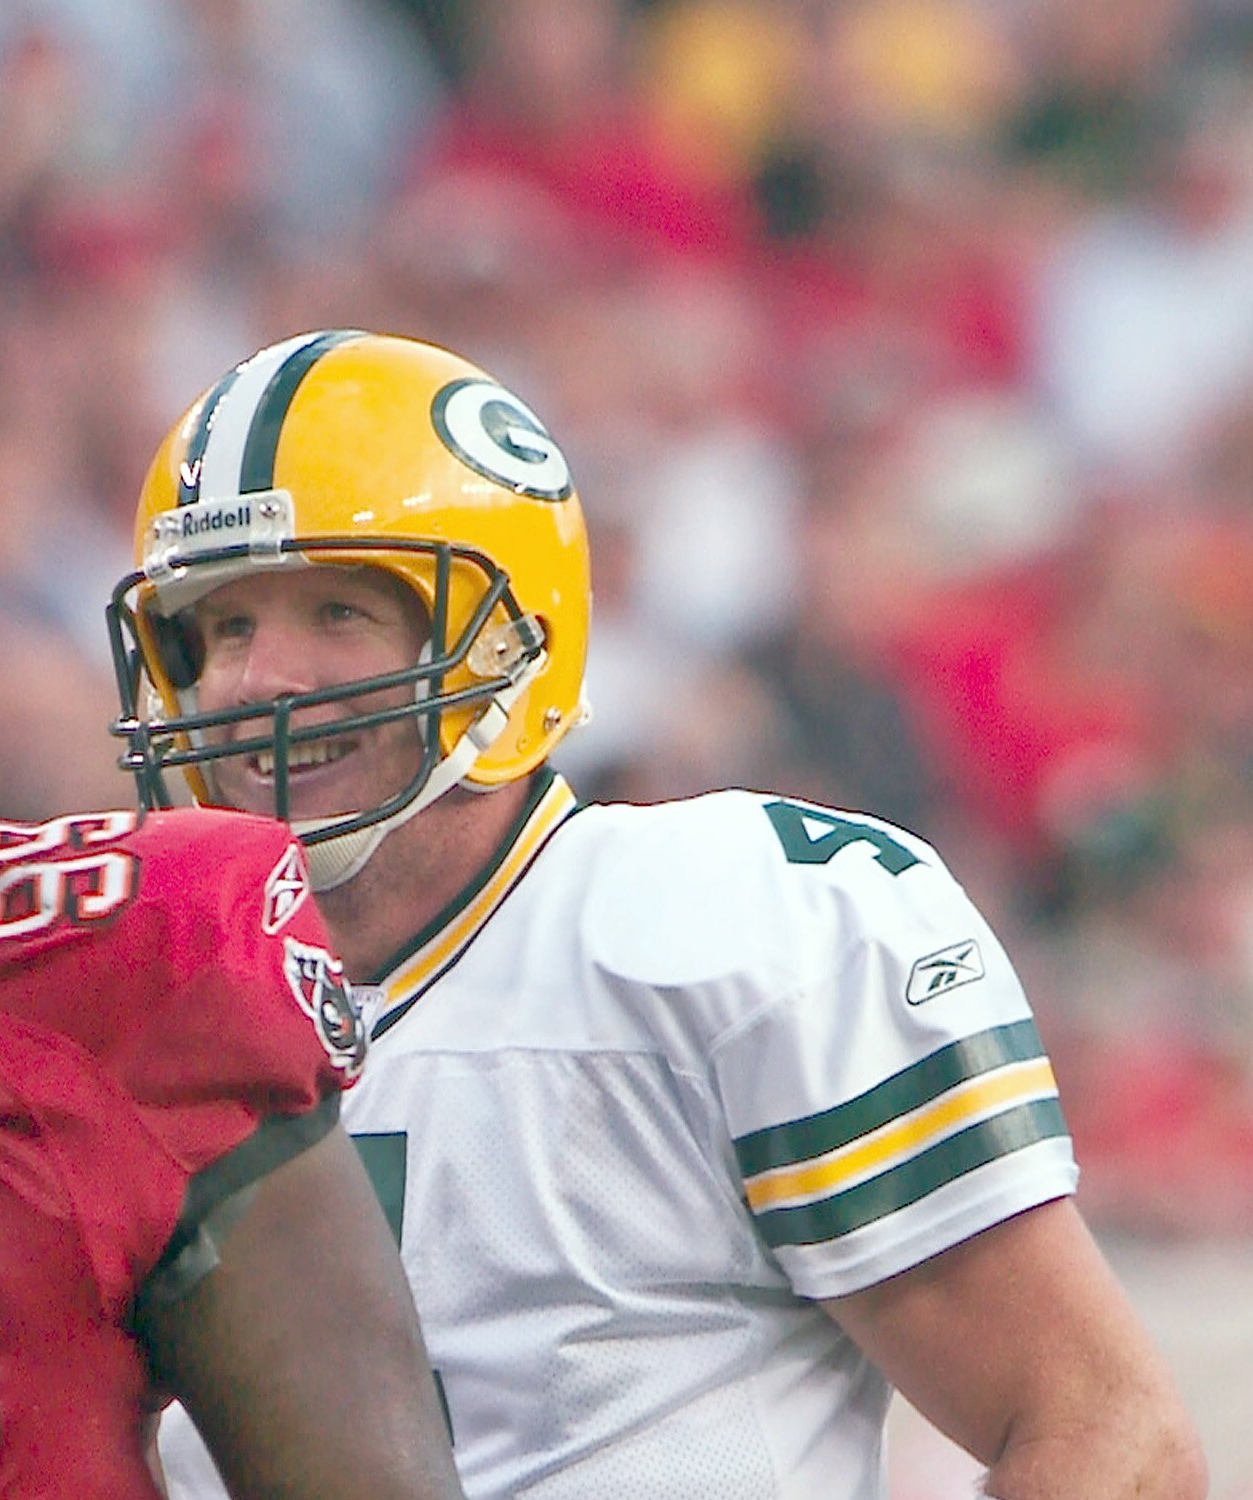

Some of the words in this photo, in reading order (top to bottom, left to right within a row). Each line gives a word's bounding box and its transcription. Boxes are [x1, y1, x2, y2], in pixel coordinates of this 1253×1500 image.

[442, 383, 571, 493] G
[182, 505, 252, 538] Riddell
[762, 801, 922, 876] 4
